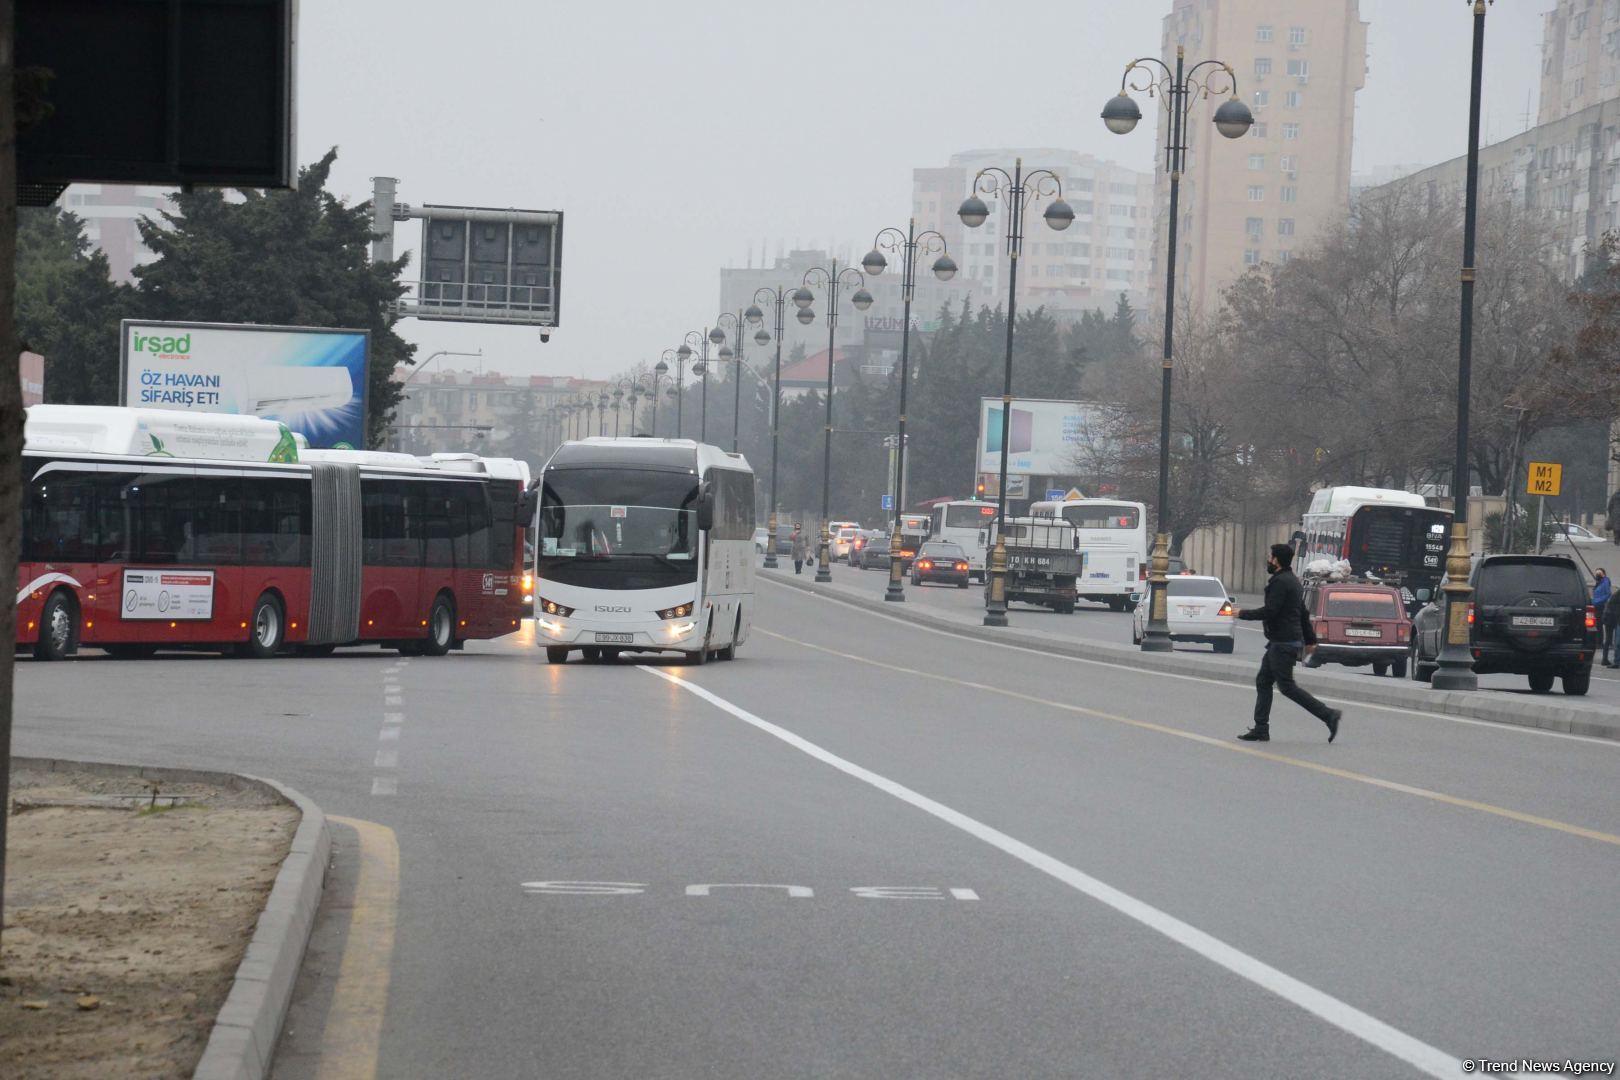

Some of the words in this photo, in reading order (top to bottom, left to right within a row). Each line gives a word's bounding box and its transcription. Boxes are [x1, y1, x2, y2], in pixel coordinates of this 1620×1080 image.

[134, 331, 191, 356] irşad
[141, 369, 161, 385] ÖZ
[165, 373, 220, 388] HAVANI
[141, 386, 194, 407] SİFARİŞ
[197, 391, 219, 405] ET!
[1536, 466, 1552, 478] M1
[1535, 480, 1552, 492] M2
